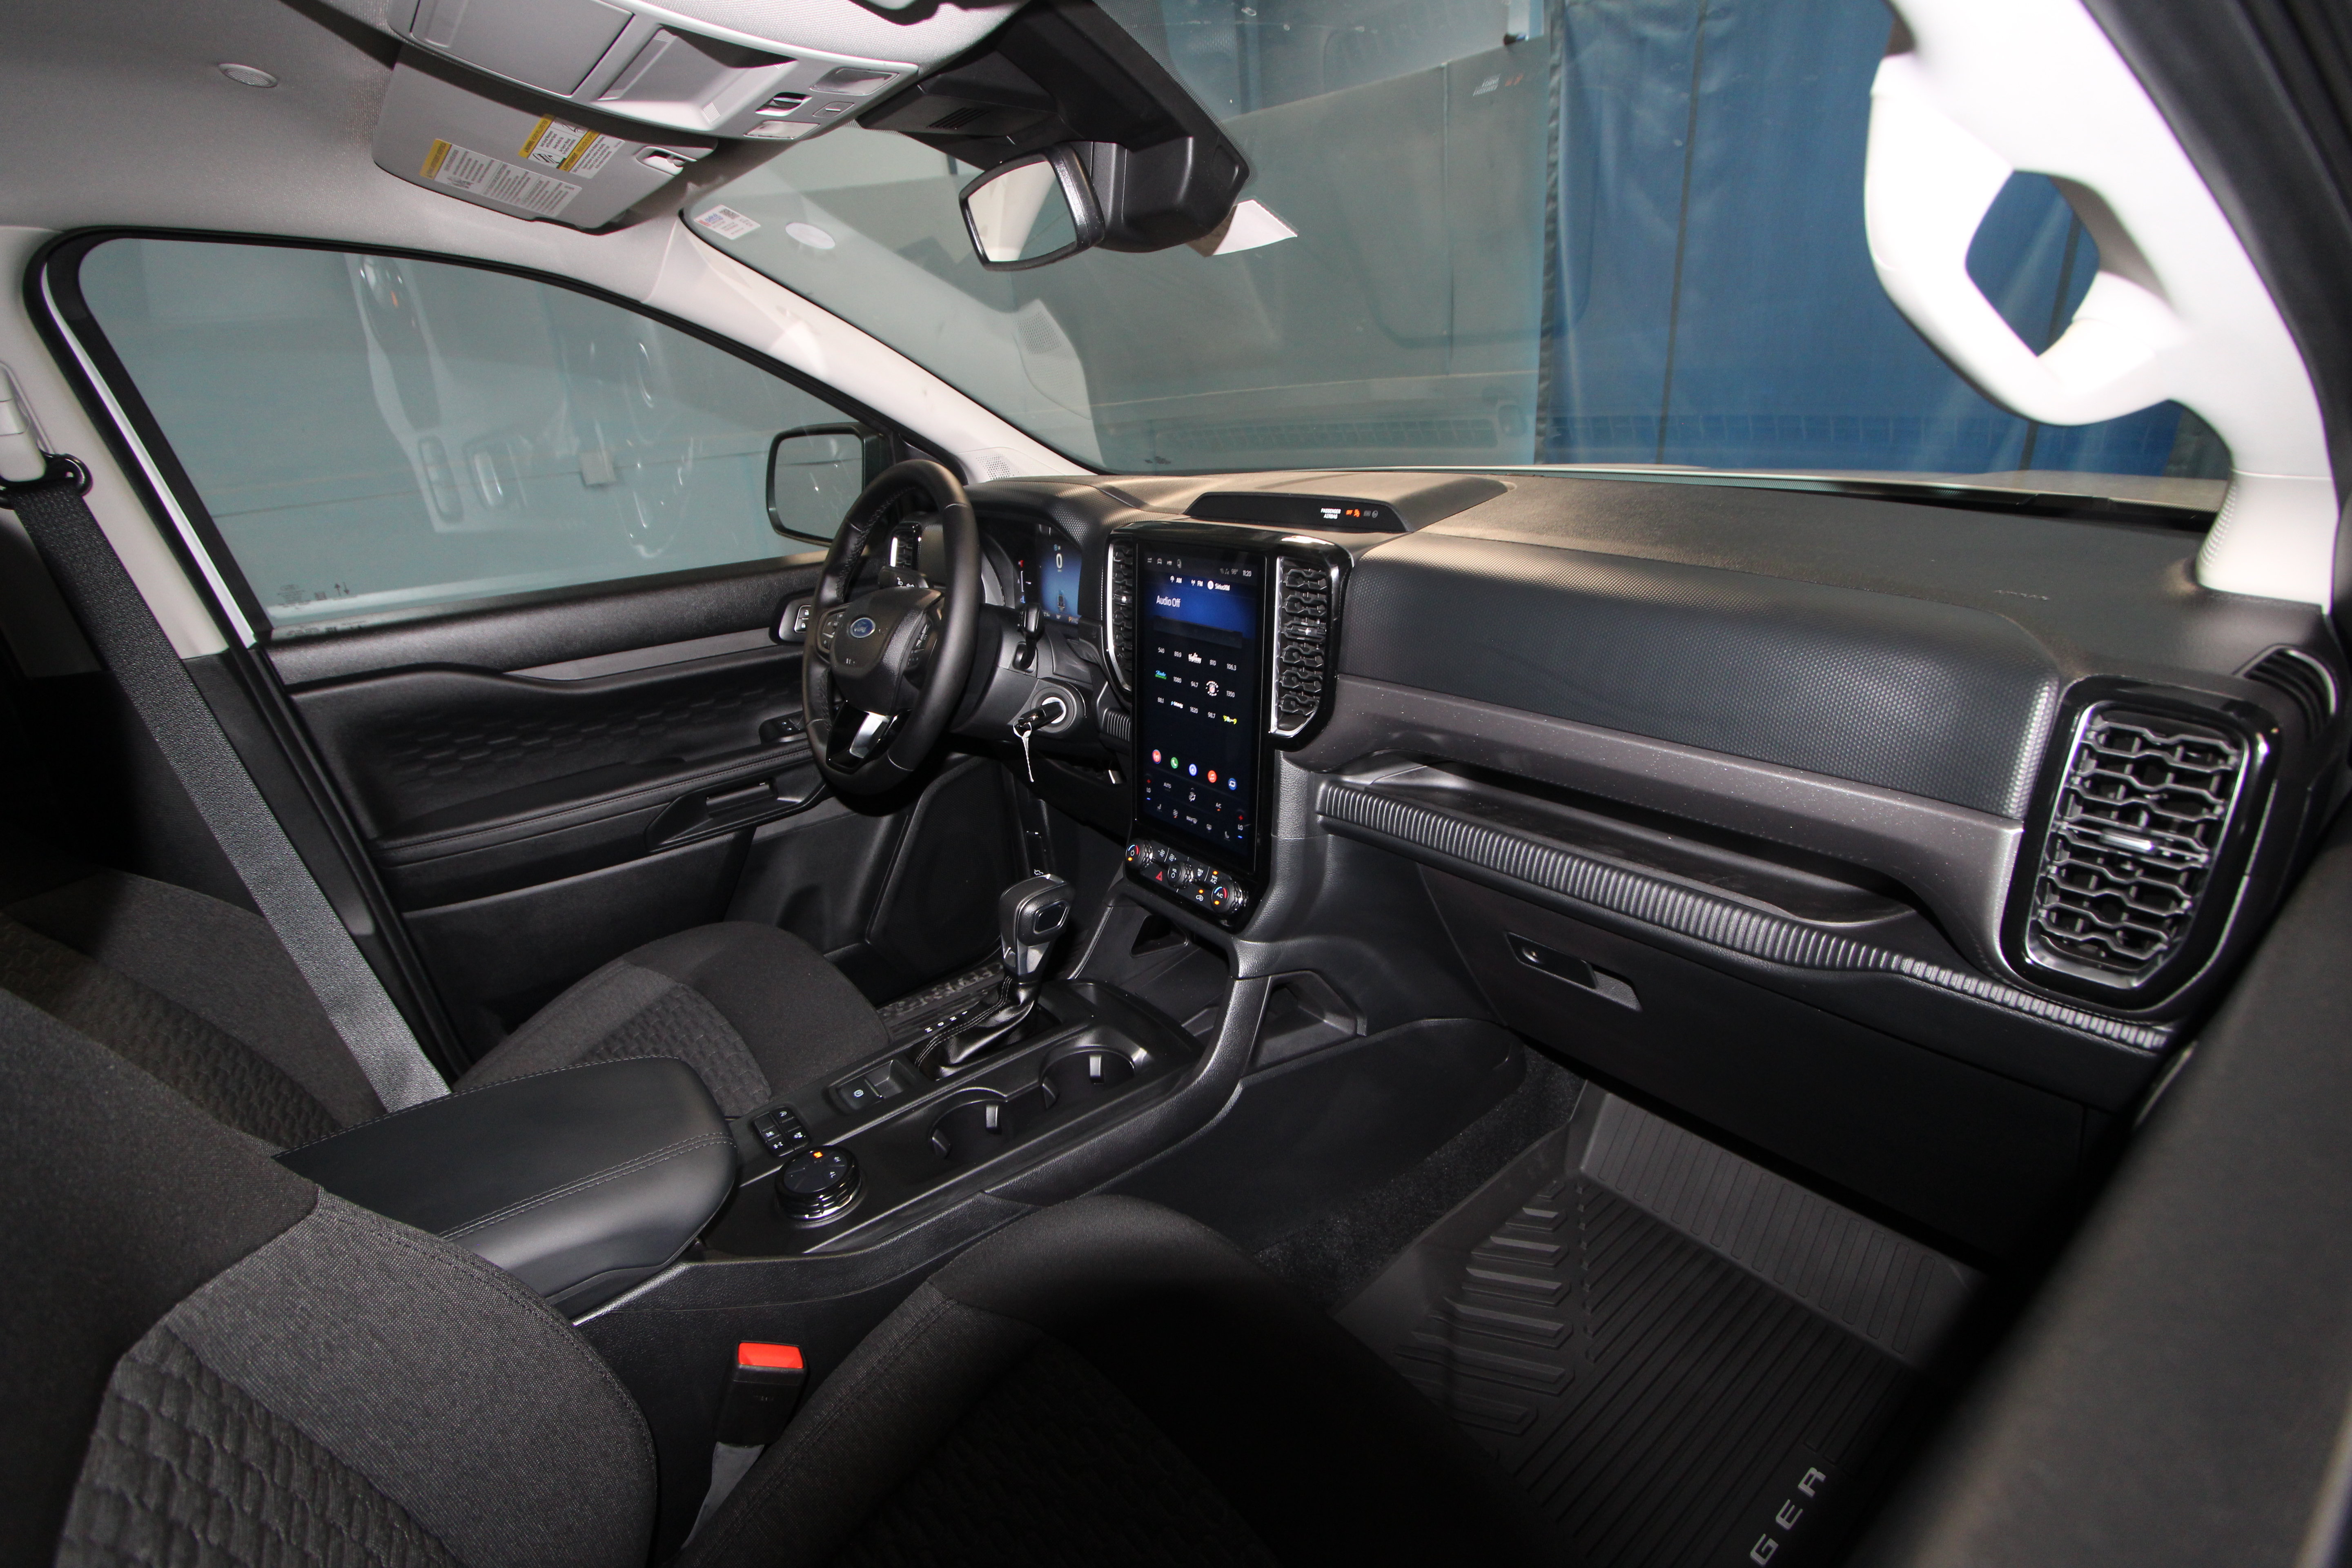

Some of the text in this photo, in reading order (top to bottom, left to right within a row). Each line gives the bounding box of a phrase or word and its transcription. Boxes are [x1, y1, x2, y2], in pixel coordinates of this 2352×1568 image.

[1056, 553, 1062, 568] 0
[1215, 583, 1230, 591] SiriusXM
[1156, 595, 1181, 608] Audio Off
[1750, 1467, 1826, 1567] GER
